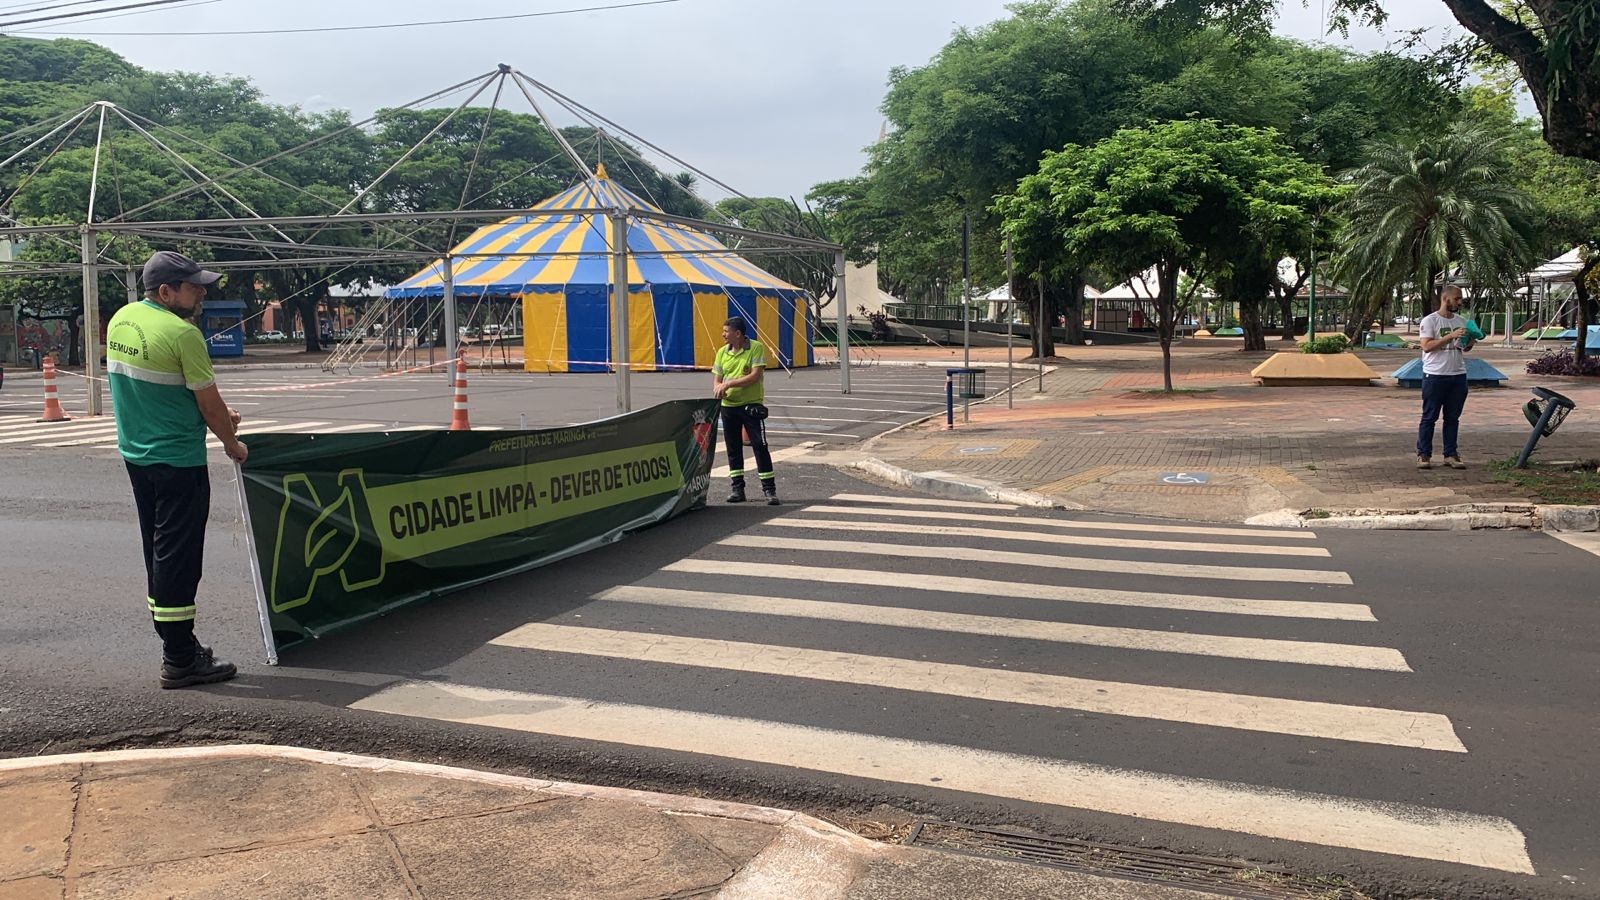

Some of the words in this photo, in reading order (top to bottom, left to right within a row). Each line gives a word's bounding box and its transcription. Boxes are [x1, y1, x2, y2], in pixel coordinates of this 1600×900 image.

[109, 341, 139, 357] SEMUSP
[489, 434, 540, 453] PREFEITURA
[541, 433, 552, 446] DE
[553, 426, 586, 444] MARINGÁ
[389, 492, 475, 540] CIDADE
[477, 481, 537, 521] LIMPA
[539, 490, 547, 498] -
[550, 468, 602, 504] DEVER
[603, 464, 623, 492] DE
[623, 455, 673, 486] TODOS!
